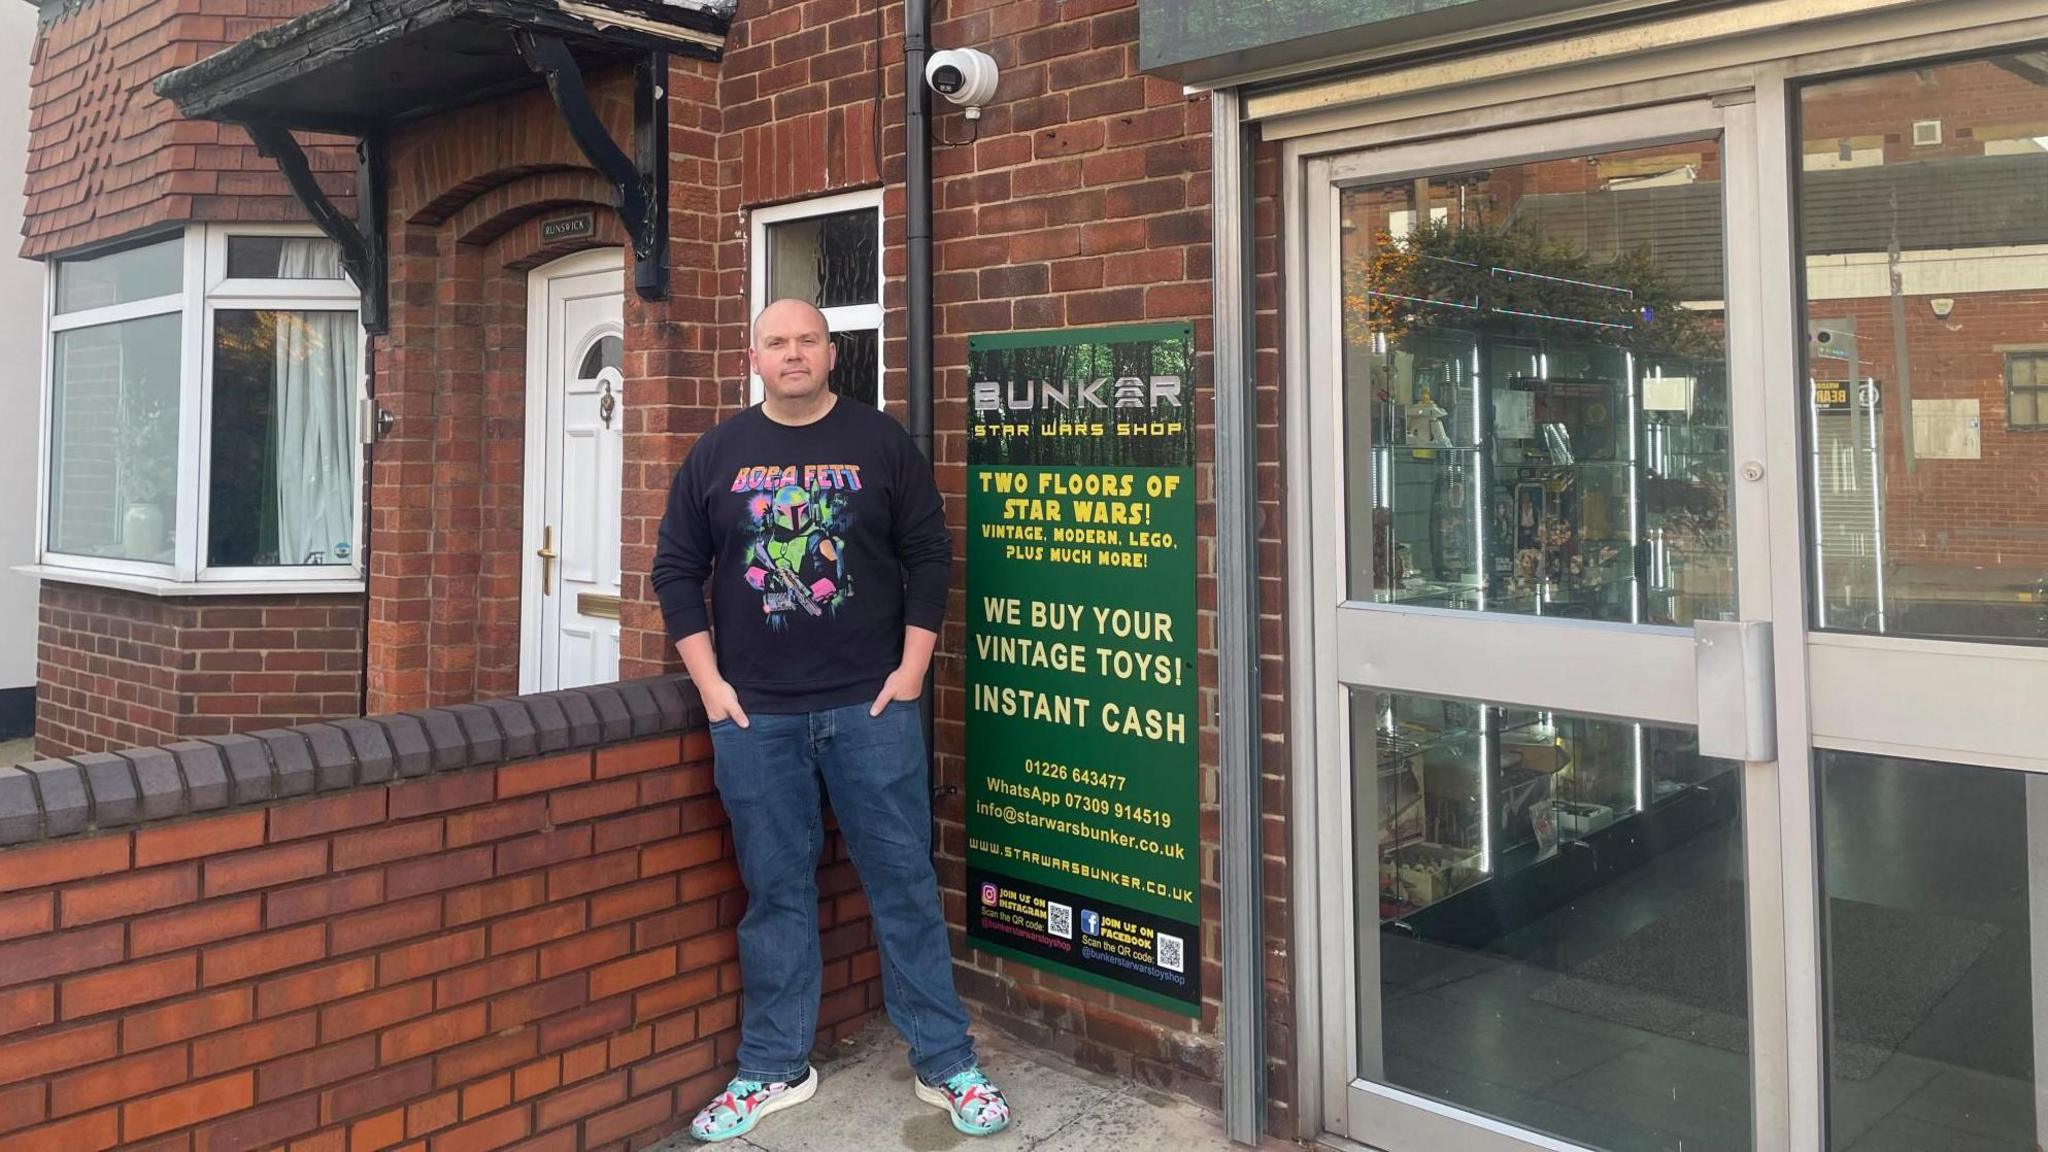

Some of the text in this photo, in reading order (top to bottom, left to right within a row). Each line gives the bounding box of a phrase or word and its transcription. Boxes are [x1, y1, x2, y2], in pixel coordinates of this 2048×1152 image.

[974, 376, 1182, 410] BUNKER
[974, 422, 1182, 437] STAR WARS SHOP
[730, 464, 862, 492] BOBA FETT
[979, 472, 1180, 498] TWO FLOORS OF
[1003, 498, 1151, 526] STAR WARS!
[1006, 545, 1147, 569] PLUS MUCH MORE!
[984, 596, 1174, 643] WE BUY YOUR
[976, 634, 1182, 686] VINTAGE TOYS!
[974, 683, 1185, 744] INSTANT CASH
[1025, 759, 1126, 791] 01226 643477
[987, 777, 1171, 828] WhatsApp 07309 914519
[976, 800, 1185, 860] info@starwarsbunker.co.uk
[999, 899, 1047, 919] INSTAGRAM
[1000, 888, 1046, 908] JOIN US ON
[981, 906, 998, 918] Scan
[1000, 911, 1010, 922] the
[1012, 914, 1024, 926] QR
[1101, 916, 1153, 939] JOIN US ON
[1082, 934, 1155, 964] Scan the QR code:
[1101, 928, 1151, 950] FACEBOOK
